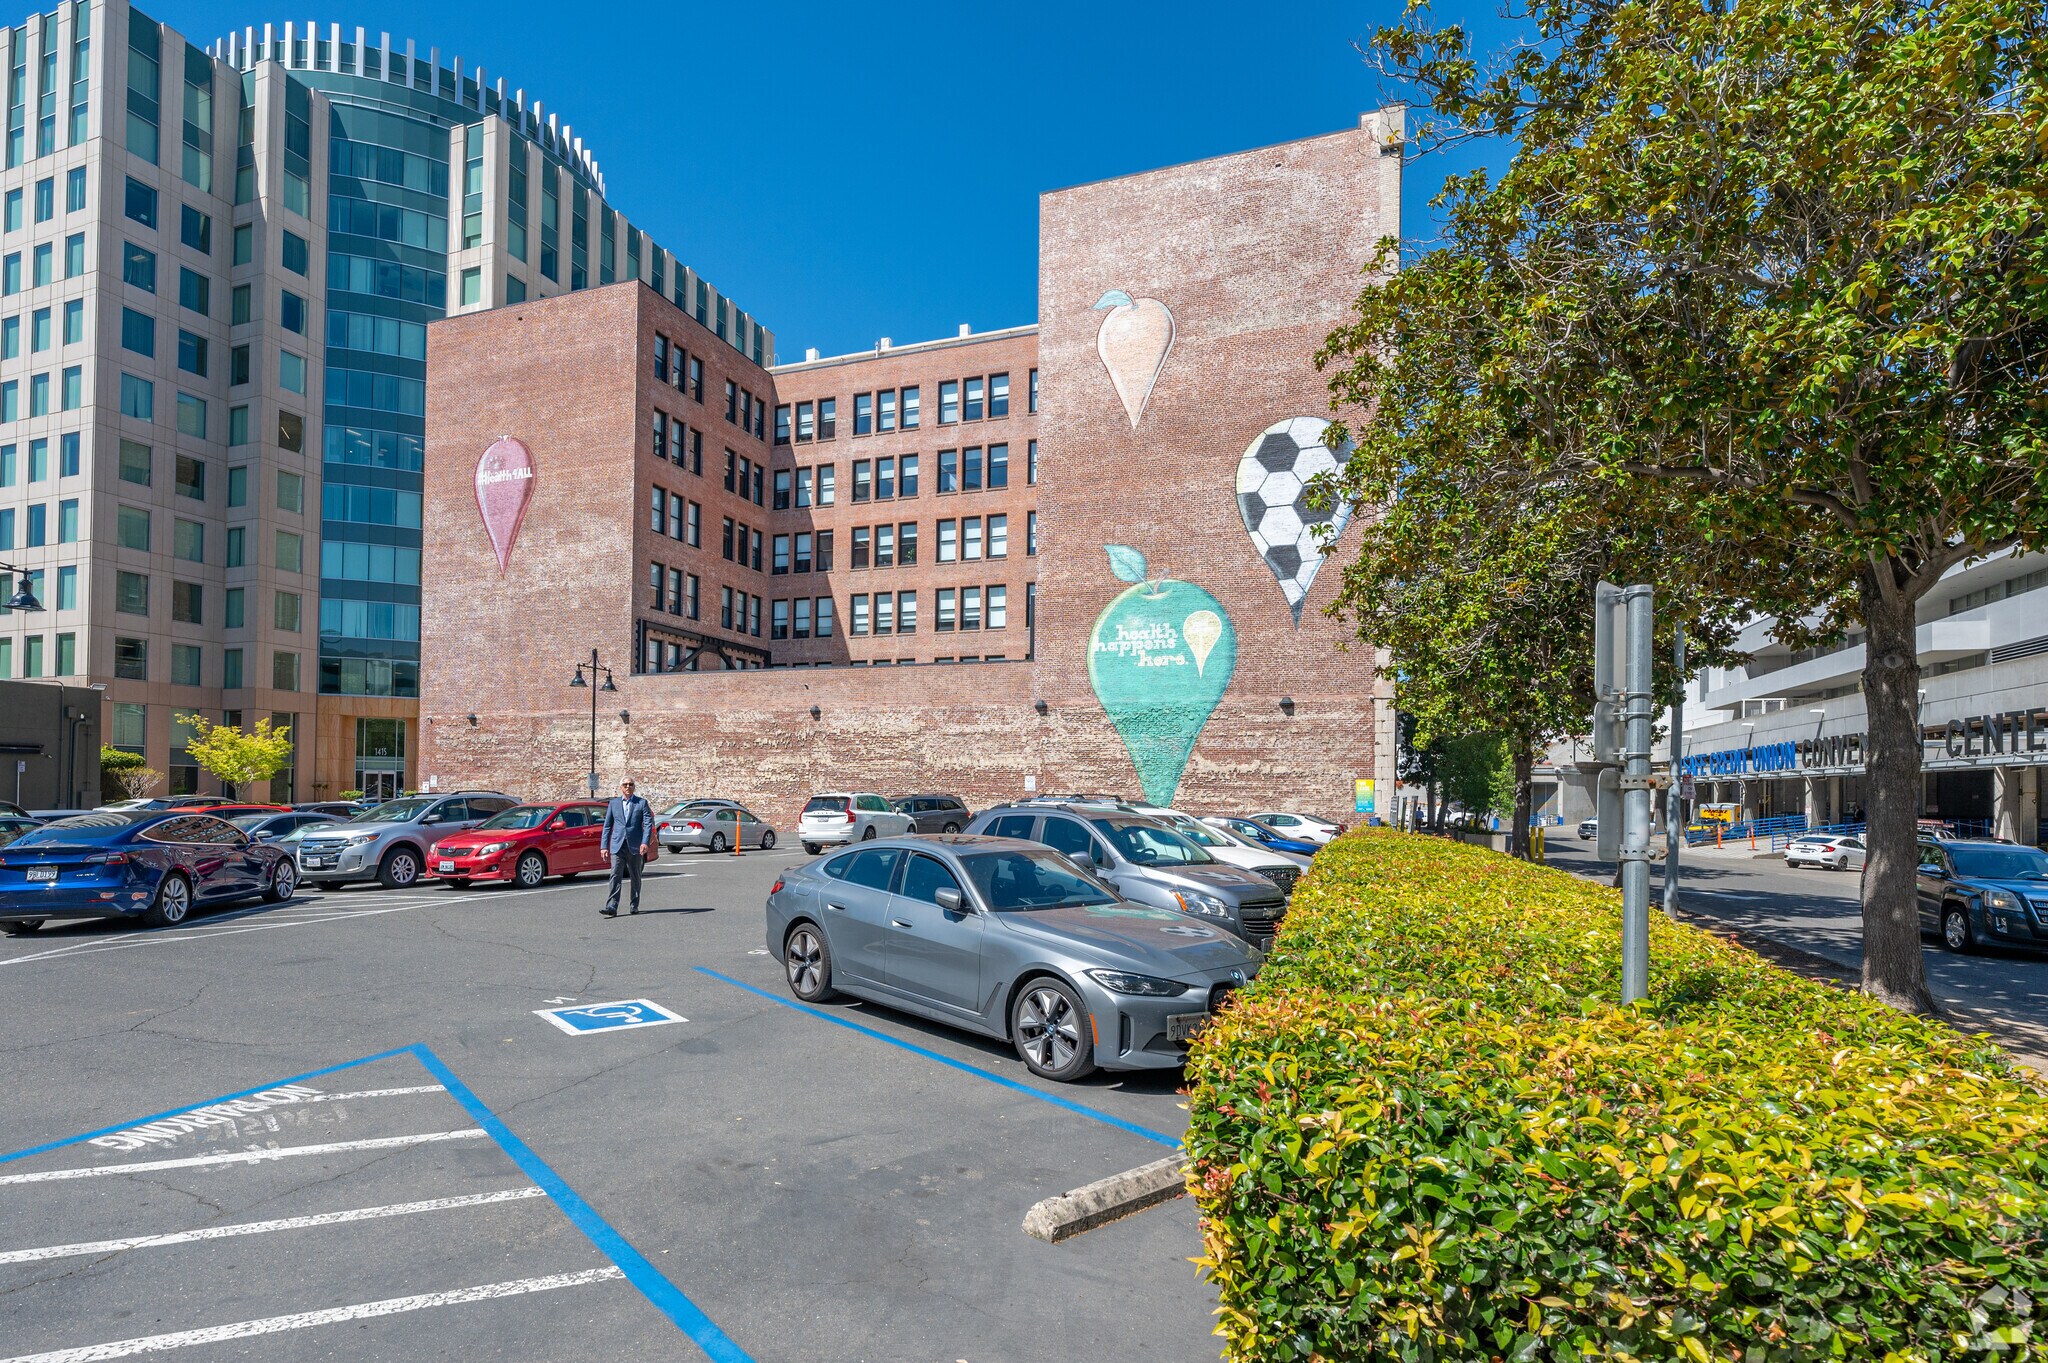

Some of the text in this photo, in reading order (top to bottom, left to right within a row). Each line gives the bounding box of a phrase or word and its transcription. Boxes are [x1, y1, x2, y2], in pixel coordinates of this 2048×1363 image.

[1115, 622, 1178, 641] health
[1093, 635, 1176, 657] happens
[374, 747, 387, 756] 1415
[1683, 753, 1707, 776] SAFE
[1709, 747, 1749, 775] CREDIT
[1752, 740, 1796, 772] UNION
[252, 1084, 324, 1103] NO
[87, 1099, 272, 1151] PARKING
